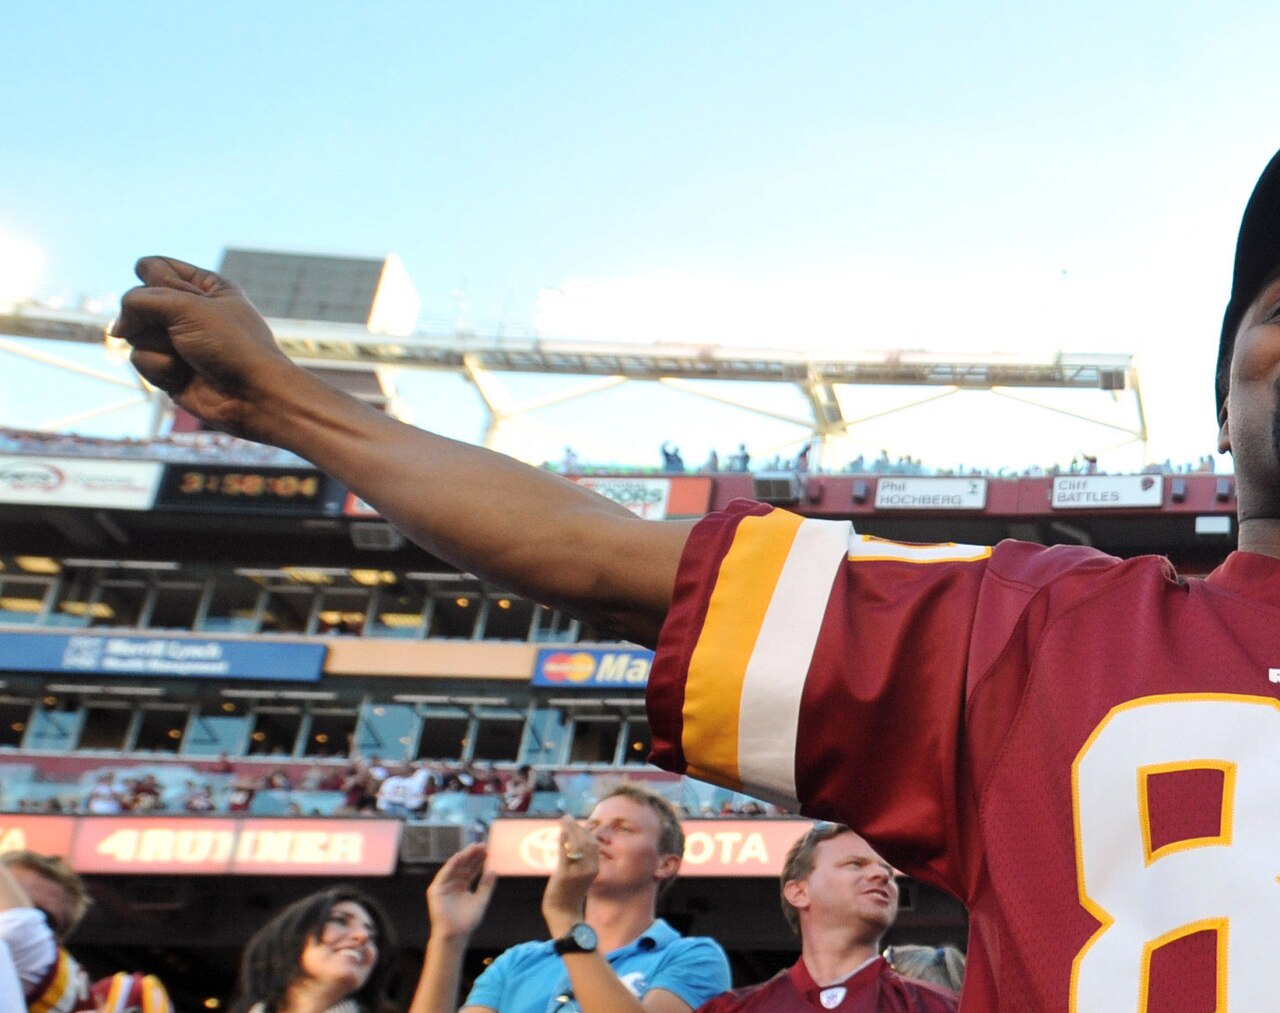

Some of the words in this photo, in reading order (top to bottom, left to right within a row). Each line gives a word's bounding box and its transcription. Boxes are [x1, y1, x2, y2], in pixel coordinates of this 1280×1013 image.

[880, 481, 906, 491] Phil
[1057, 480, 1088, 490] Cliff
[879, 494, 962, 505] HOCHBERG
[1056, 491, 1119, 503] BATTLES
[595, 653, 649, 683] Ma
[683, 831, 769, 865] OTA
